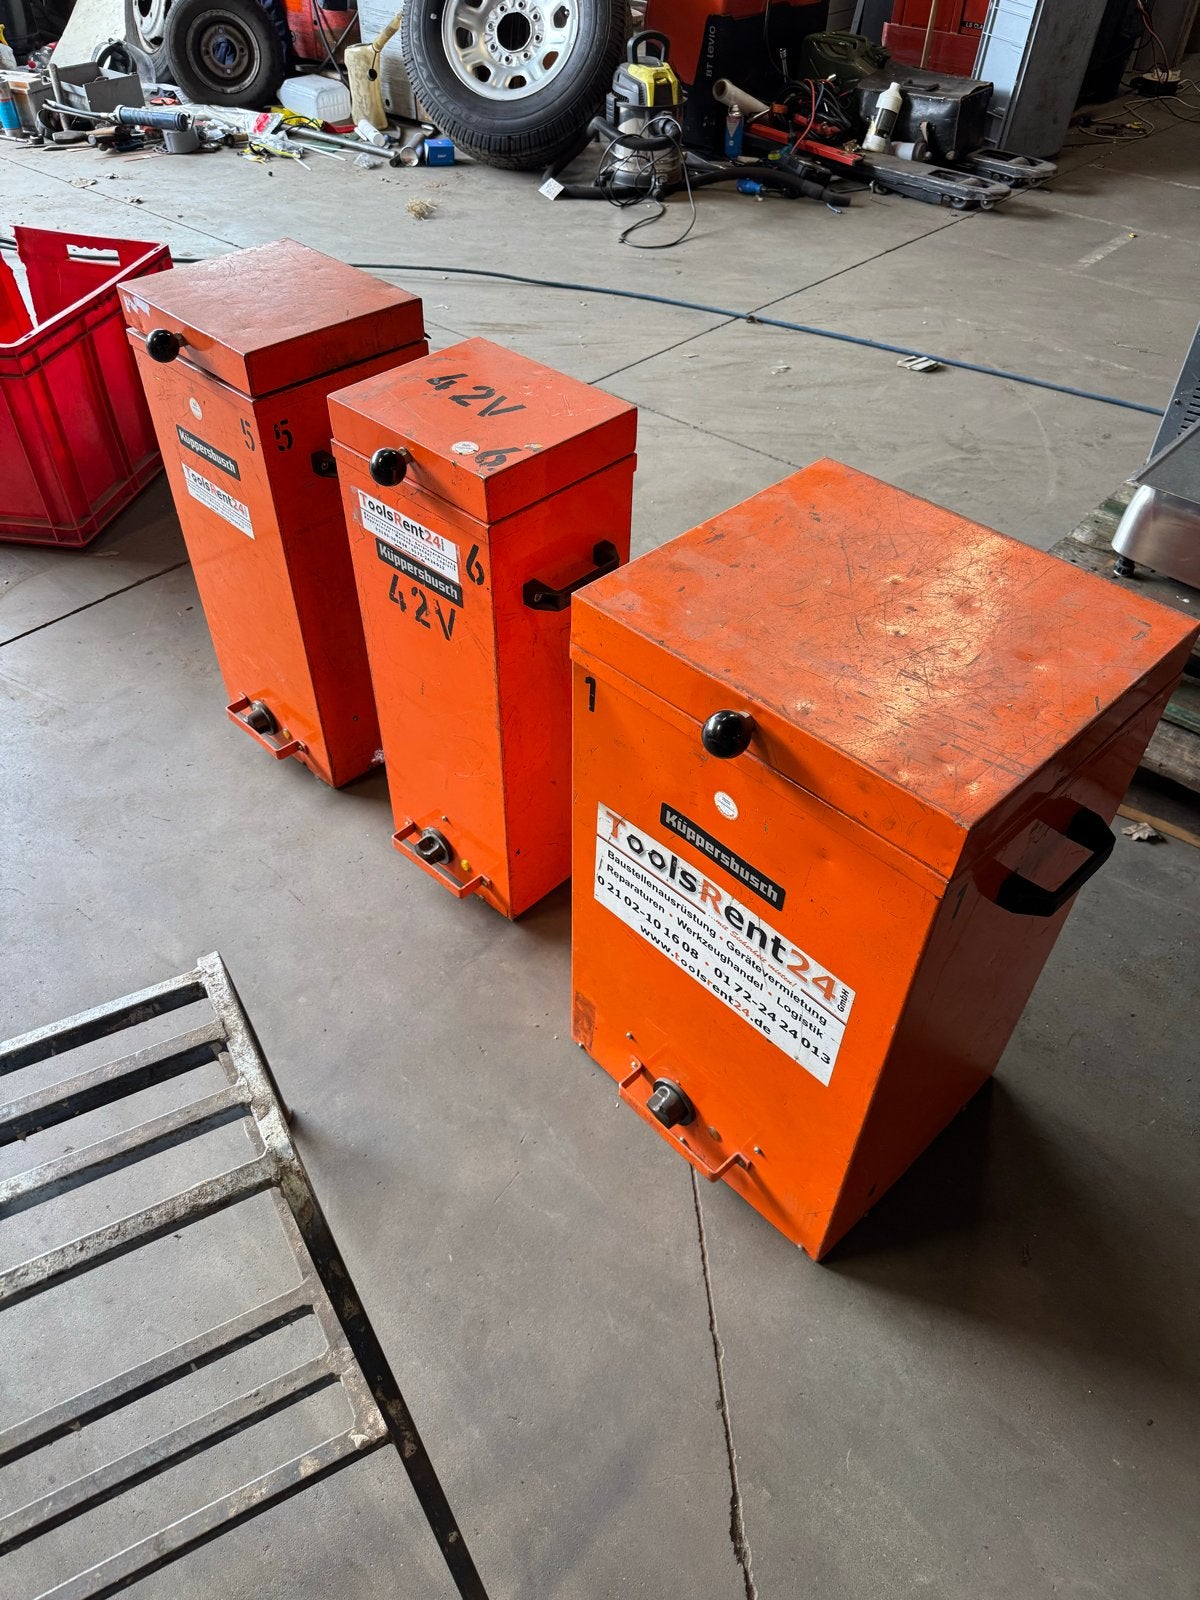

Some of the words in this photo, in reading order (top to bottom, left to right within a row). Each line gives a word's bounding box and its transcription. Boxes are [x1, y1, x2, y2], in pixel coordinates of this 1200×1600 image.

[425, 373, 527, 417] 42V
[178, 429, 237, 474] Küppersbusch
[240, 417, 255, 451] 5
[273, 419, 294, 451] 5
[474, 446, 522, 468] 6
[185, 467, 245, 514] ToolsRent24
[359, 492, 441, 551] ToolsRent24
[379, 542, 458, 600] Küppersbusch
[465, 543, 485, 586] 6
[388, 573, 456, 642] 42V
[585, 676, 596, 712] 1
[665, 809, 779, 903] Küppersbusch
[606, 810, 836, 1002] ToolsRent24
[606, 864, 666, 914] Reparaturen
[677, 917, 764, 991] Werkzeughandel
[776, 997, 824, 1039] Logistik
[607, 849, 717, 939] Baustellenausrüstung
[726, 940, 827, 1026] Gerätevermietung
[639, 924, 772, 1036] www.toolsrent24.de
[837, 988, 850, 1013] GmbH
